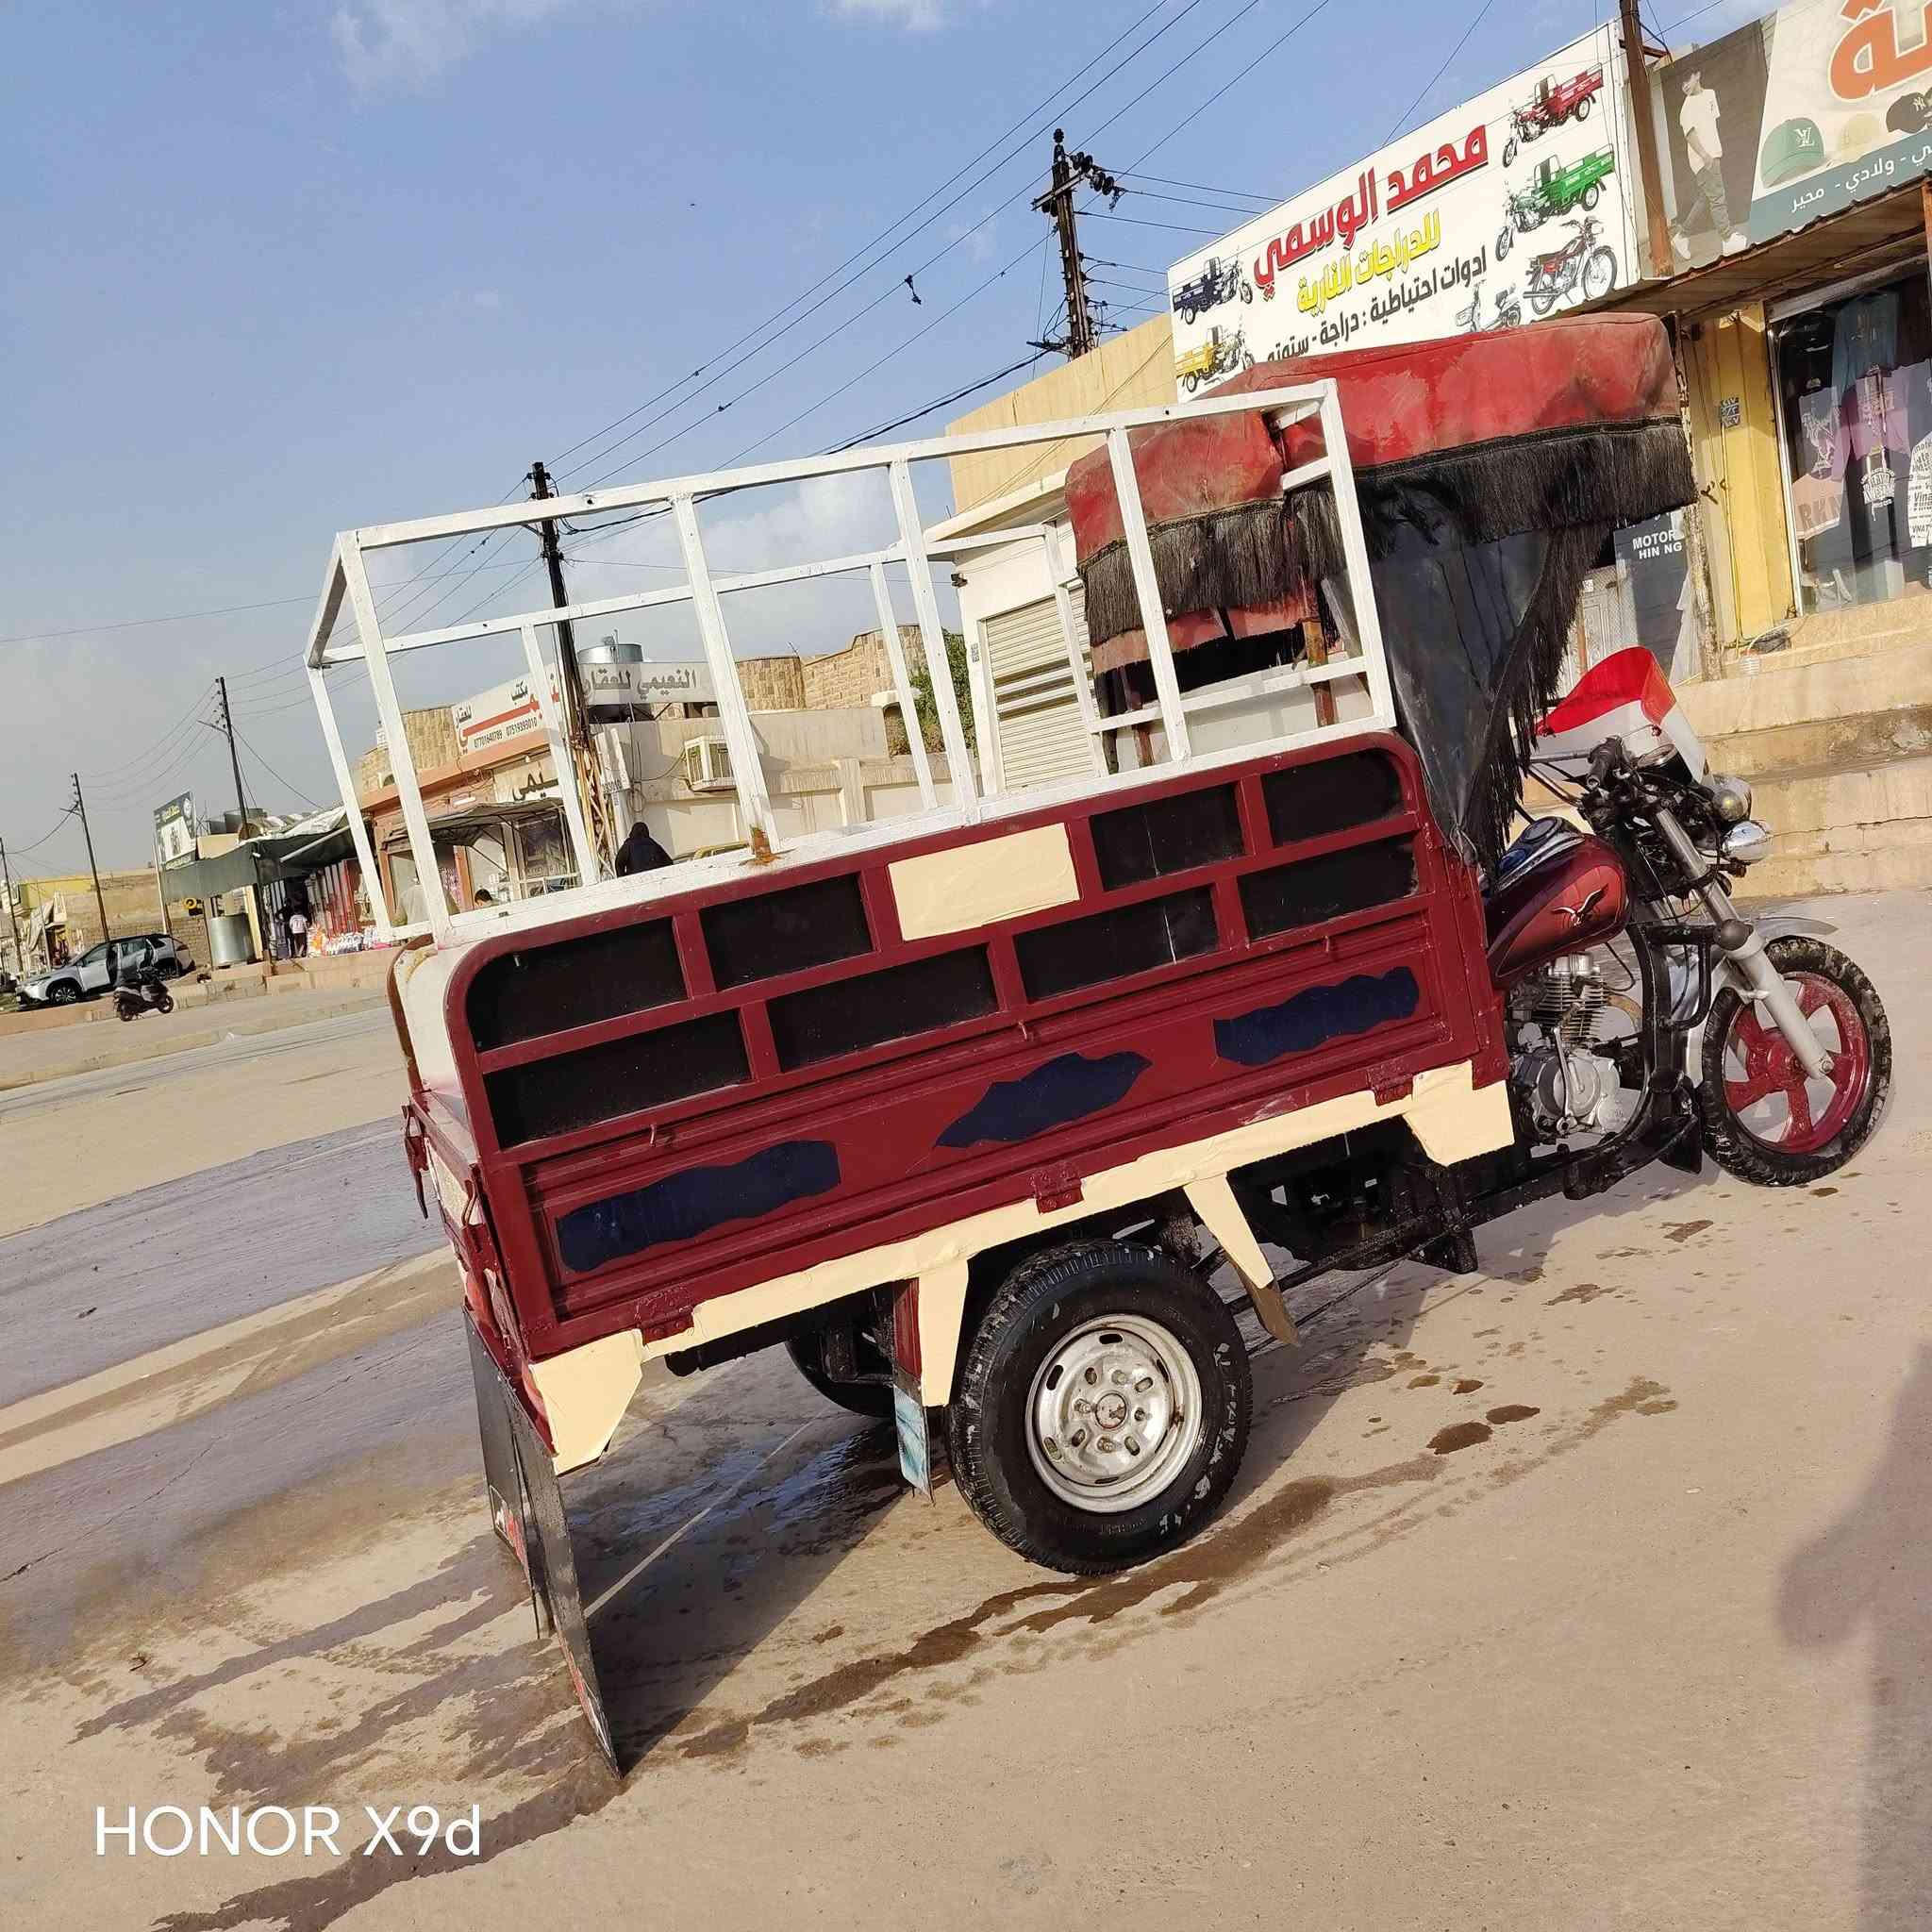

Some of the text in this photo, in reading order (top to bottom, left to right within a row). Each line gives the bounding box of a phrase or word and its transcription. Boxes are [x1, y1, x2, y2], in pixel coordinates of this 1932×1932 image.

[1845, 158, 1895, 193] ولادي
[1254, 125, 1489, 302] محمد الوسمي
[1296, 208, 1441, 318] للدراجات النارية
[1441, 244, 1488, 289] ادوات
[1370, 267, 1438, 325] احتياطية
[1320, 310, 1359, 348] دراجة
[638, 668, 697, 700] النعيمي
